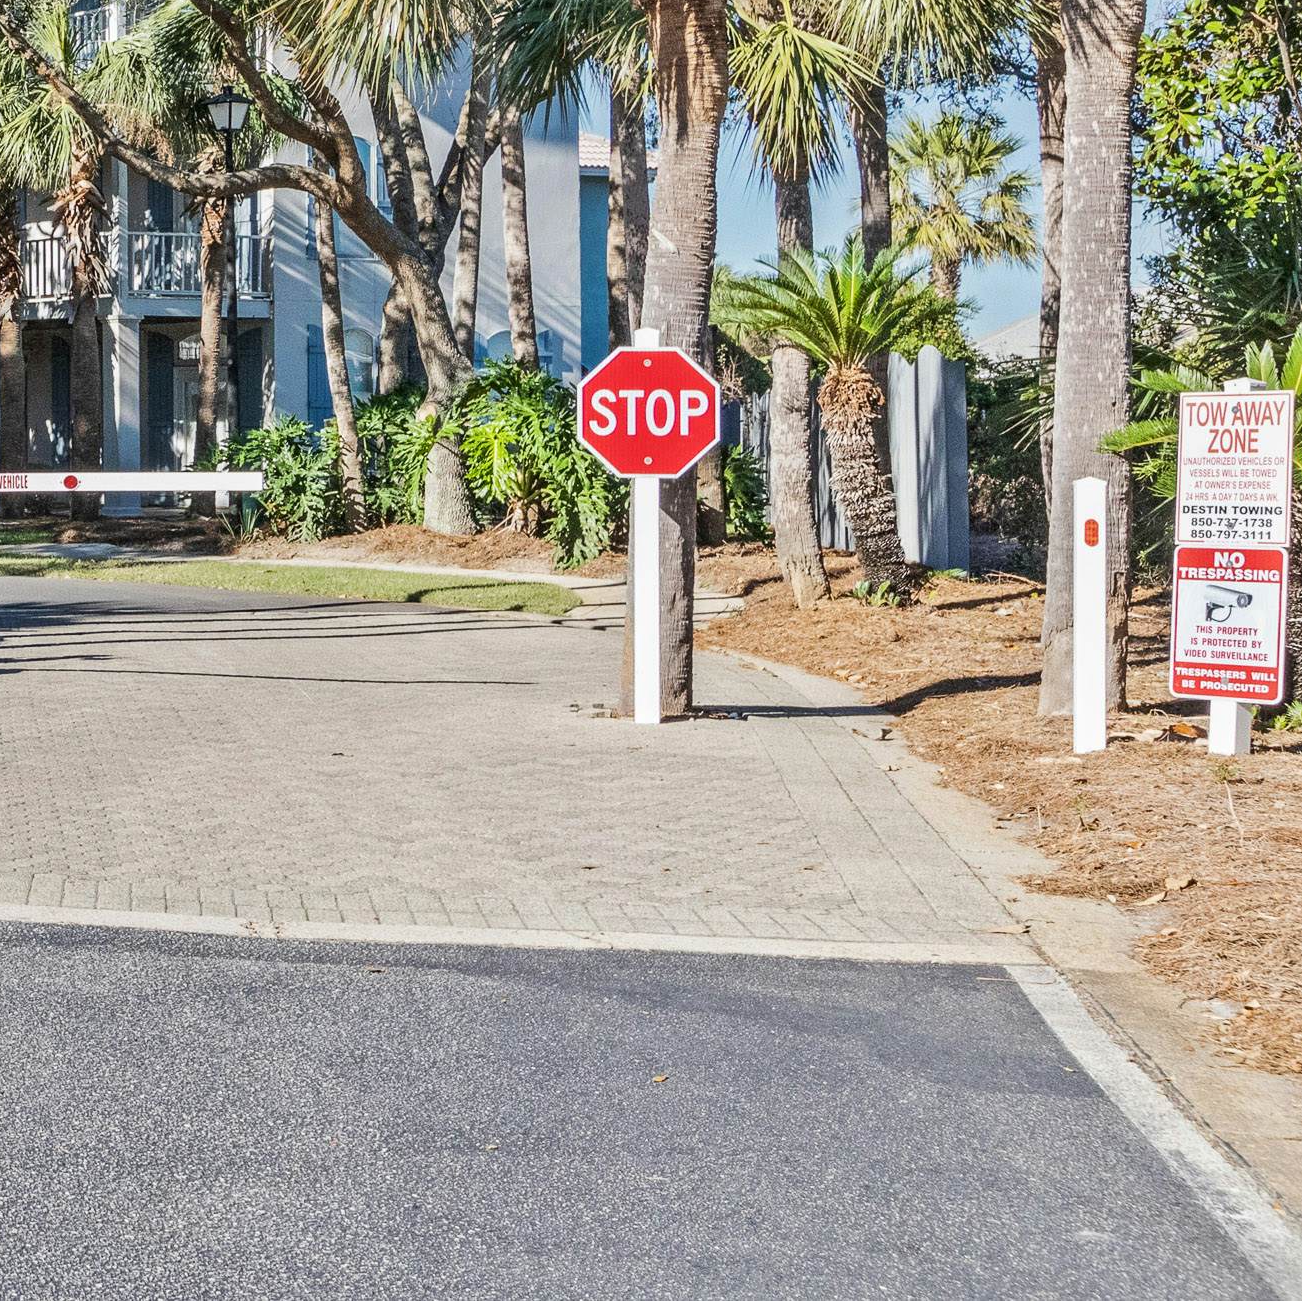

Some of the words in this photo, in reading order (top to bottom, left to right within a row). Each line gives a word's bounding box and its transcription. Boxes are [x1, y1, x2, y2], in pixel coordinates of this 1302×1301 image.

[588, 388, 710, 437] STOP
[1186, 401, 1228, 426] TOW
[1231, 401, 1285, 426] AWAY
[1207, 428, 1259, 454] ZONE
[1183, 457, 1236, 466] UNAUTHORIZED
[1238, 457, 1273, 466] VEHICLES
[1274, 457, 1285, 466] OR
[1189, 469, 1220, 478] VESSELS
[1221, 469, 1238, 478] WILL
[1240, 469, 1250, 478] BE
[1251, 469, 1278, 478] TOWED
[1194, 481, 1203, 490] AT
[1204, 481, 1237, 490] OWNER'S
[1238, 481, 1272, 490] EXPENSE
[1185, 492, 1193, 501] 24
[1212, 492, 1217, 501] A
[1218, 492, 1232, 501] DAY
[1239, 492, 1258, 502] DAYS
[1259, 493, 1265, 502] A
[1182, 505, 1227, 514] DESTIN
[1231, 506, 1283, 515] TOWING
[1191, 517, 1273, 528] 850-737-1738
[1190, 529, 1272, 540] 850-797-3111
[1214, 551, 1246, 568] NO
[1178, 567, 1280, 581] TRESPASSING
[1196, 625, 1213, 634] THIS
[1216, 626, 1258, 636] PROPERTY
[1190, 637, 1198, 645] IS
[1202, 638, 1248, 648] PROTECTED
[1251, 640, 1262, 649] BY
[1184, 649, 1207, 658] VIDEO
[1210, 650, 1269, 662] SURVEILLANCE
[1175, 666, 1247, 680] TRESPASSERS
[1250, 671, 1277, 682] WILL
[1181, 679, 1196, 688] BE
[1200, 680, 1270, 693] PROSECUTED
